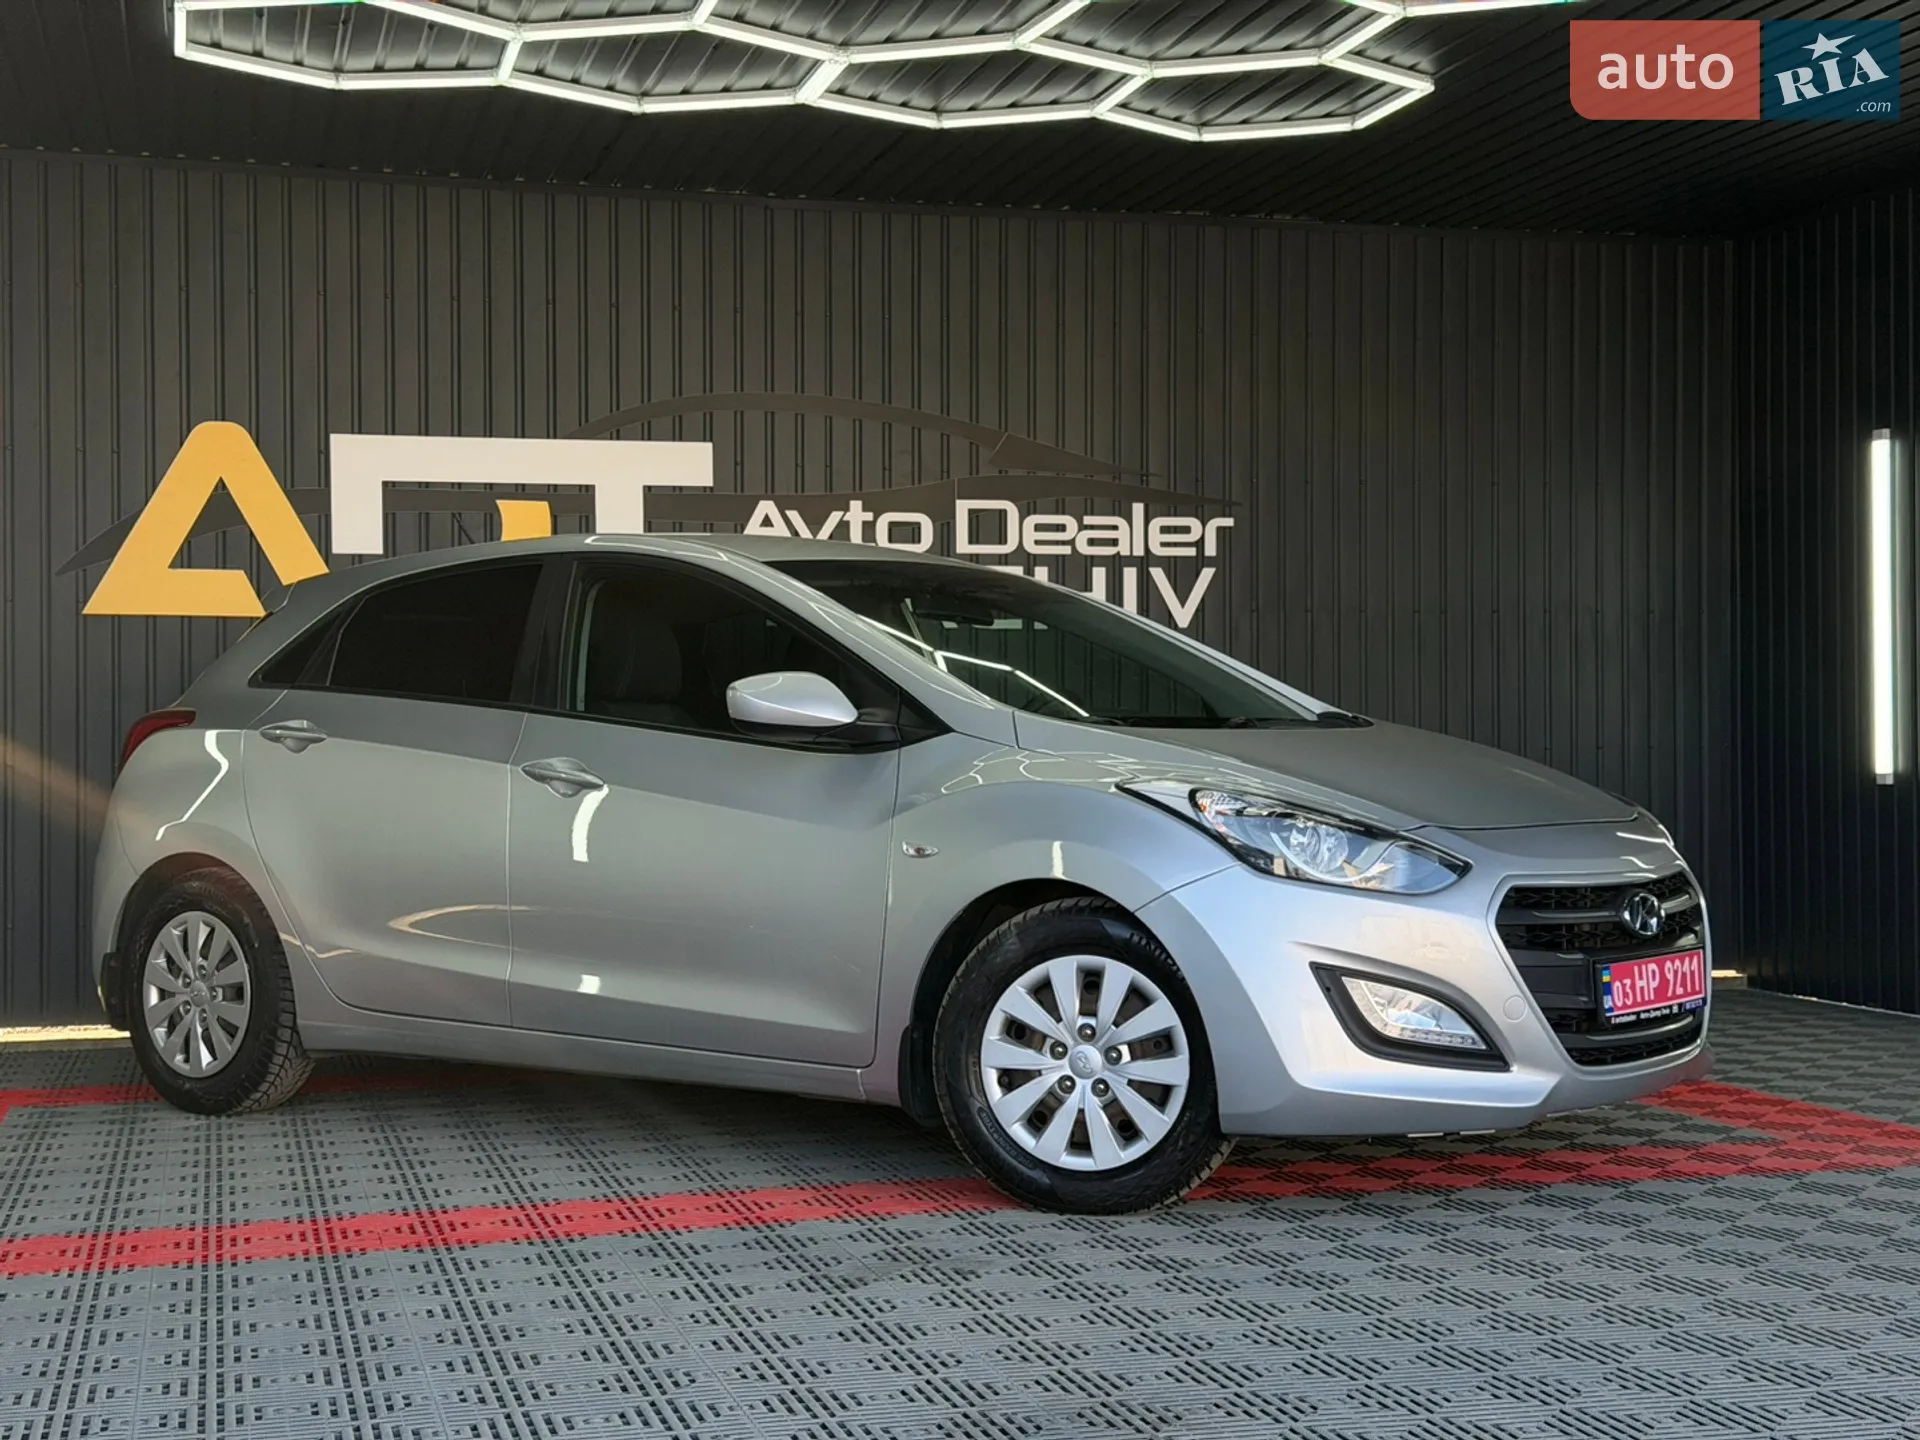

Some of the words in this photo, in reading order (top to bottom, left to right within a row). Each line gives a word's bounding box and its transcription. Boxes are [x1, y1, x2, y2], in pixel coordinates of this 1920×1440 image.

[742, 499, 933, 553] Avto
[955, 499, 1235, 557] Dealer
[1664, 955, 1700, 997] 9211
